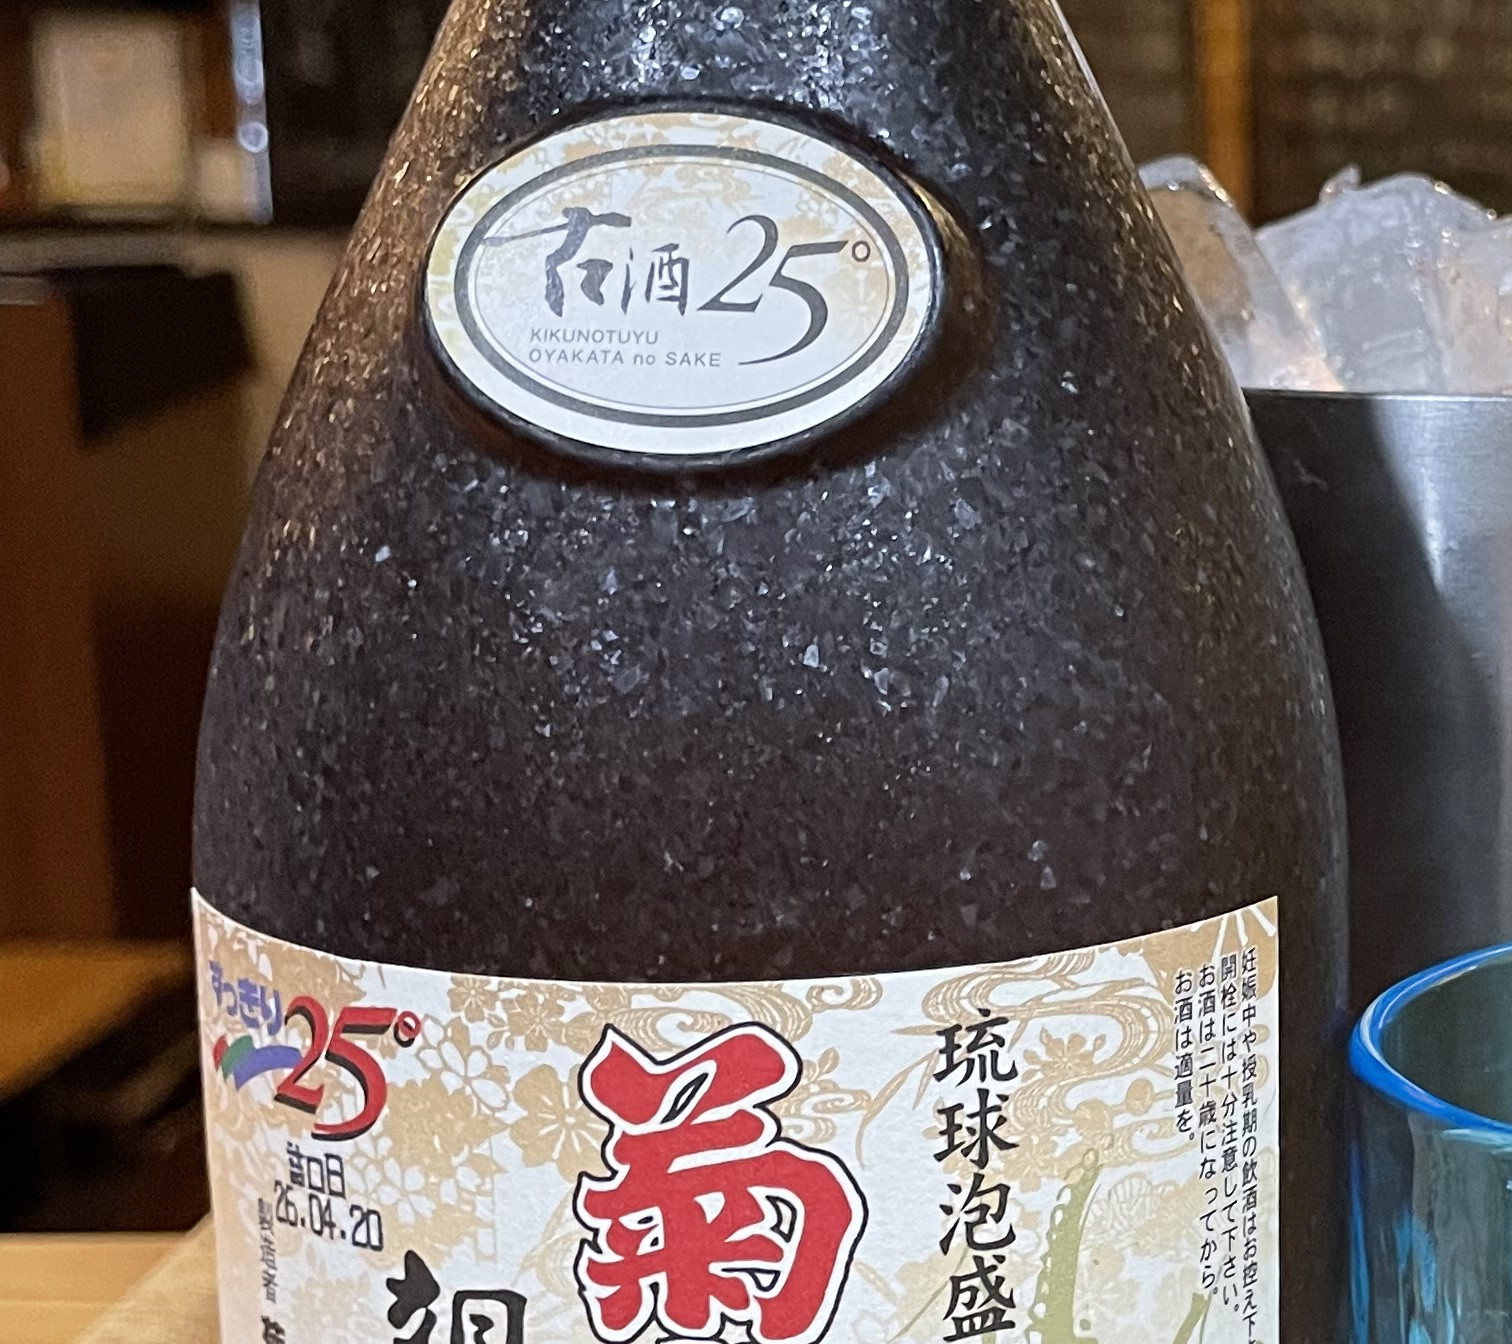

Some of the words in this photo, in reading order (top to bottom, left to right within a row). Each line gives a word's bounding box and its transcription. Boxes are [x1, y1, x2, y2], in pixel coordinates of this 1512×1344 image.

[529, 327, 659, 347] KIKUNOTUYU
[529, 347, 624, 365] OYAKATA
[633, 351, 656, 366] no
[665, 350, 721, 368] SAKE
[1174, 970, 1194, 1141] お酒は適量を。
[1198, 964, 1219, 1295] お酒は二十歳になってから。
[1220, 954, 1239, 1312] 開栓には十分注意して下さい。
